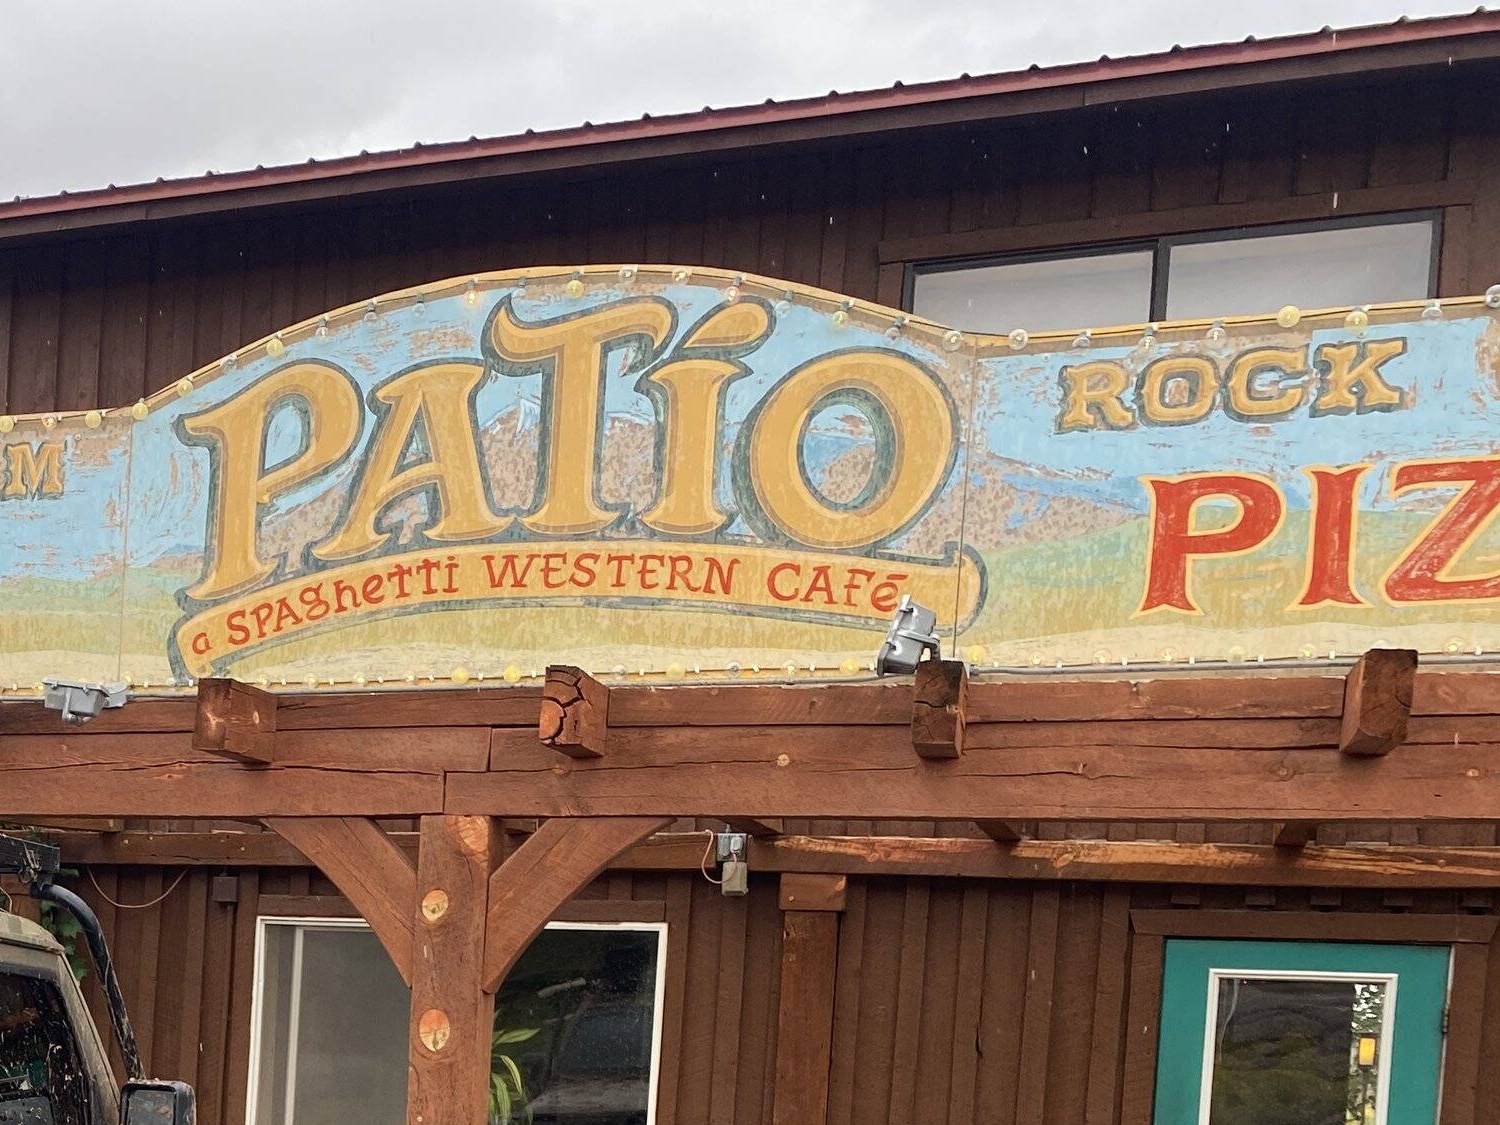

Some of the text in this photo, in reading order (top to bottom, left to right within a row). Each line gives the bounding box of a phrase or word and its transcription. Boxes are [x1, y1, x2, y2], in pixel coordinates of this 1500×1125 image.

[1056, 337, 1407, 434] ROCK
[191, 632, 212, 654] a
[481, 553, 741, 595] WESTERN
